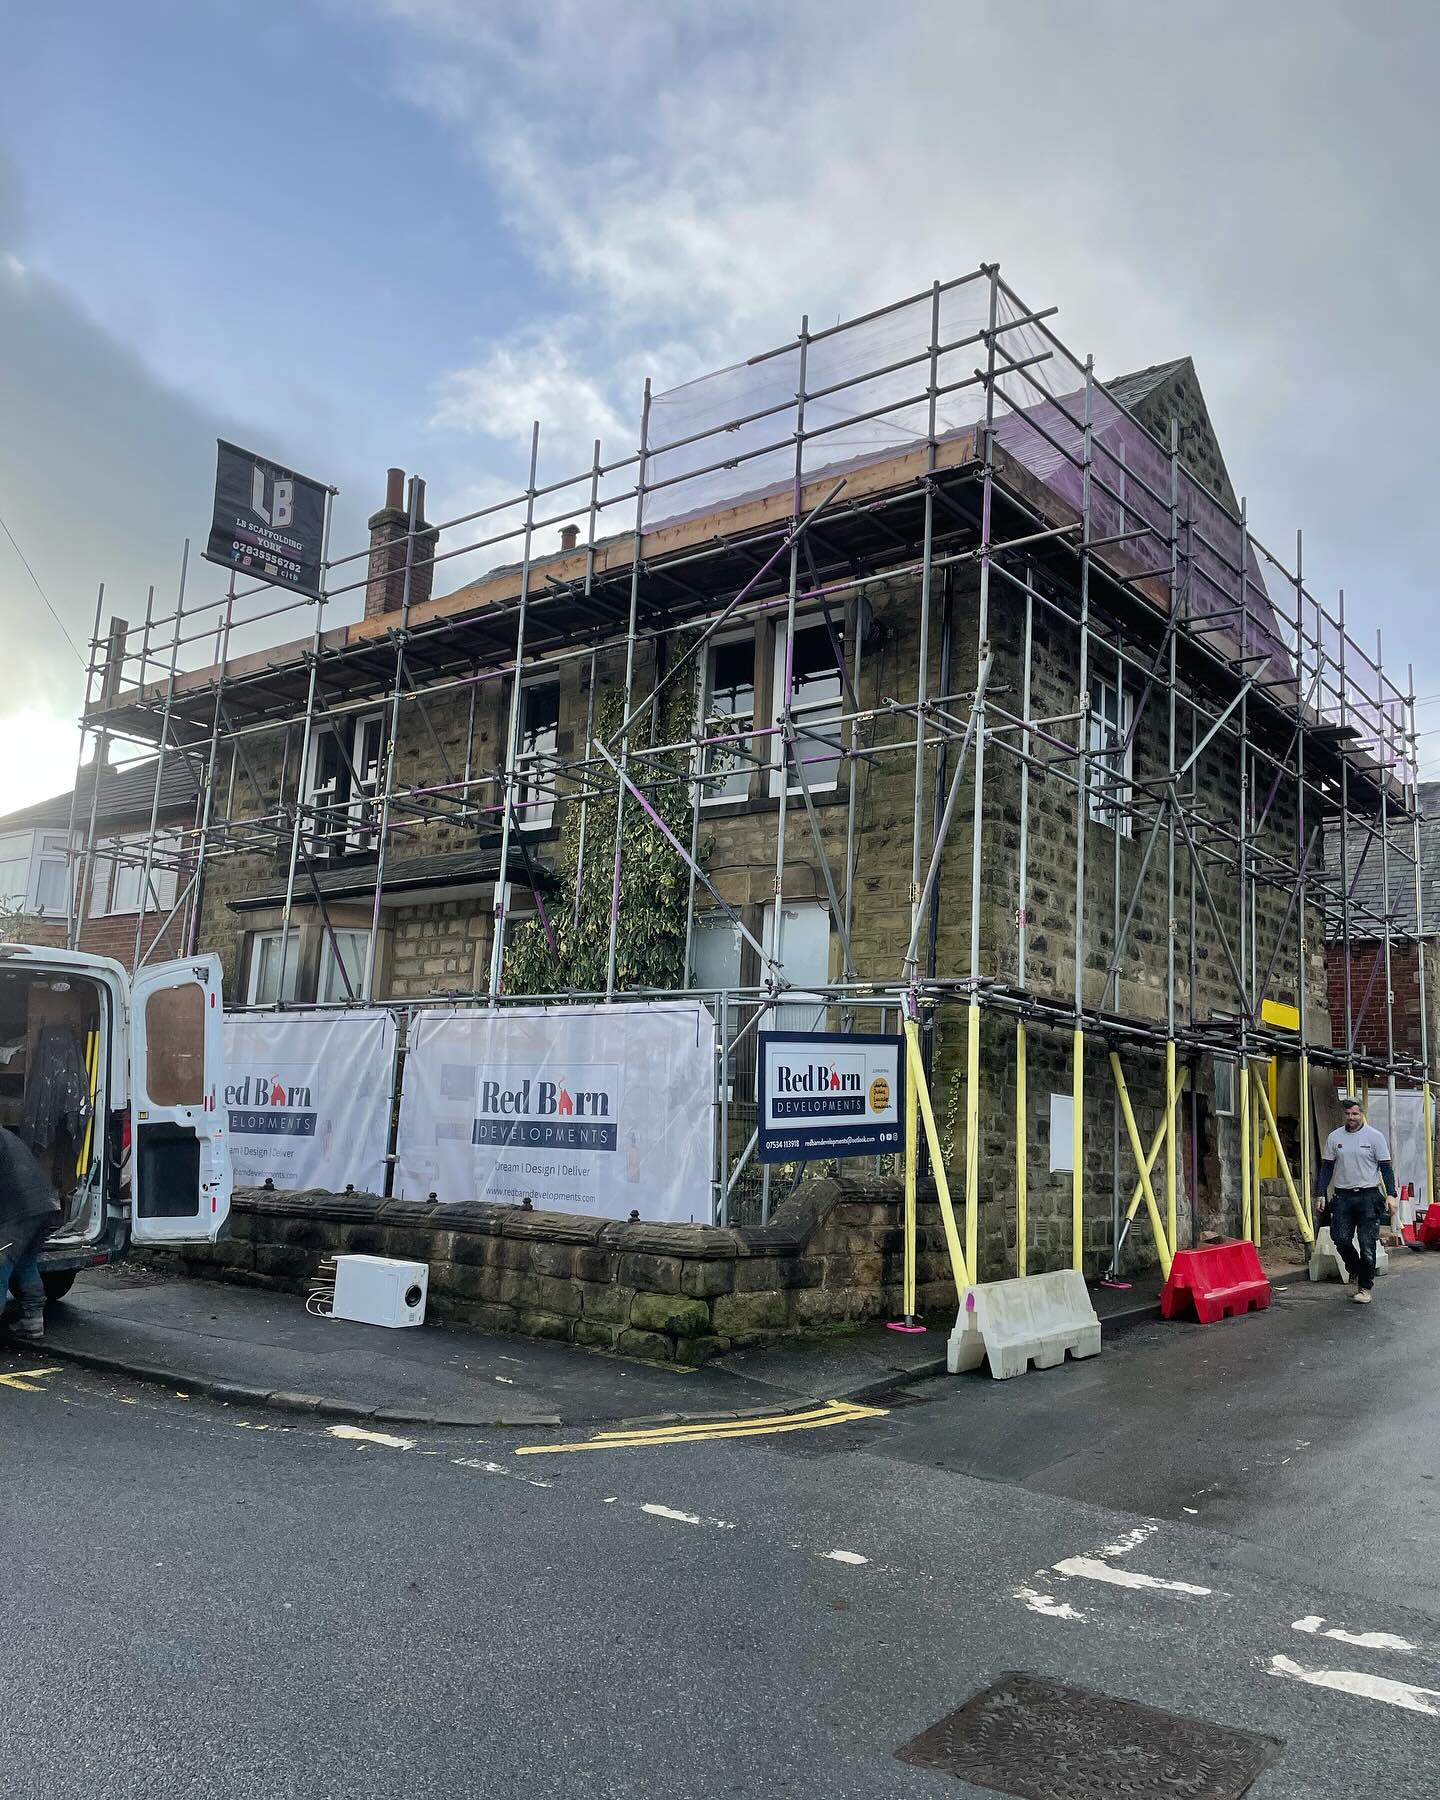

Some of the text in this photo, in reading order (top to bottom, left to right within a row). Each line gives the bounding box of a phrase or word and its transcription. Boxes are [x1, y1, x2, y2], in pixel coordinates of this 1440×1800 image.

[236, 518, 302, 551] LB SCAFFOLDING
[257, 537, 282, 554] YORK
[232, 541, 301, 572] 07835556782
[777, 1064, 814, 1092] Red
[224, 1076, 250, 1106] ed
[481, 1080, 530, 1115] Red
[777, 1100, 861, 1113] DEVELOPMENTS
[232, 1116, 310, 1130] ELOPMENTS
[480, 1125, 608, 1143] DEVELOPMENTS
[243, 1146, 268, 1158] Design
[765, 1140, 783, 1149] 07534
[495, 1161, 590, 1177] Dream Design Deliver
[486, 1187, 596, 1203] www.redbarndevelopments.com
